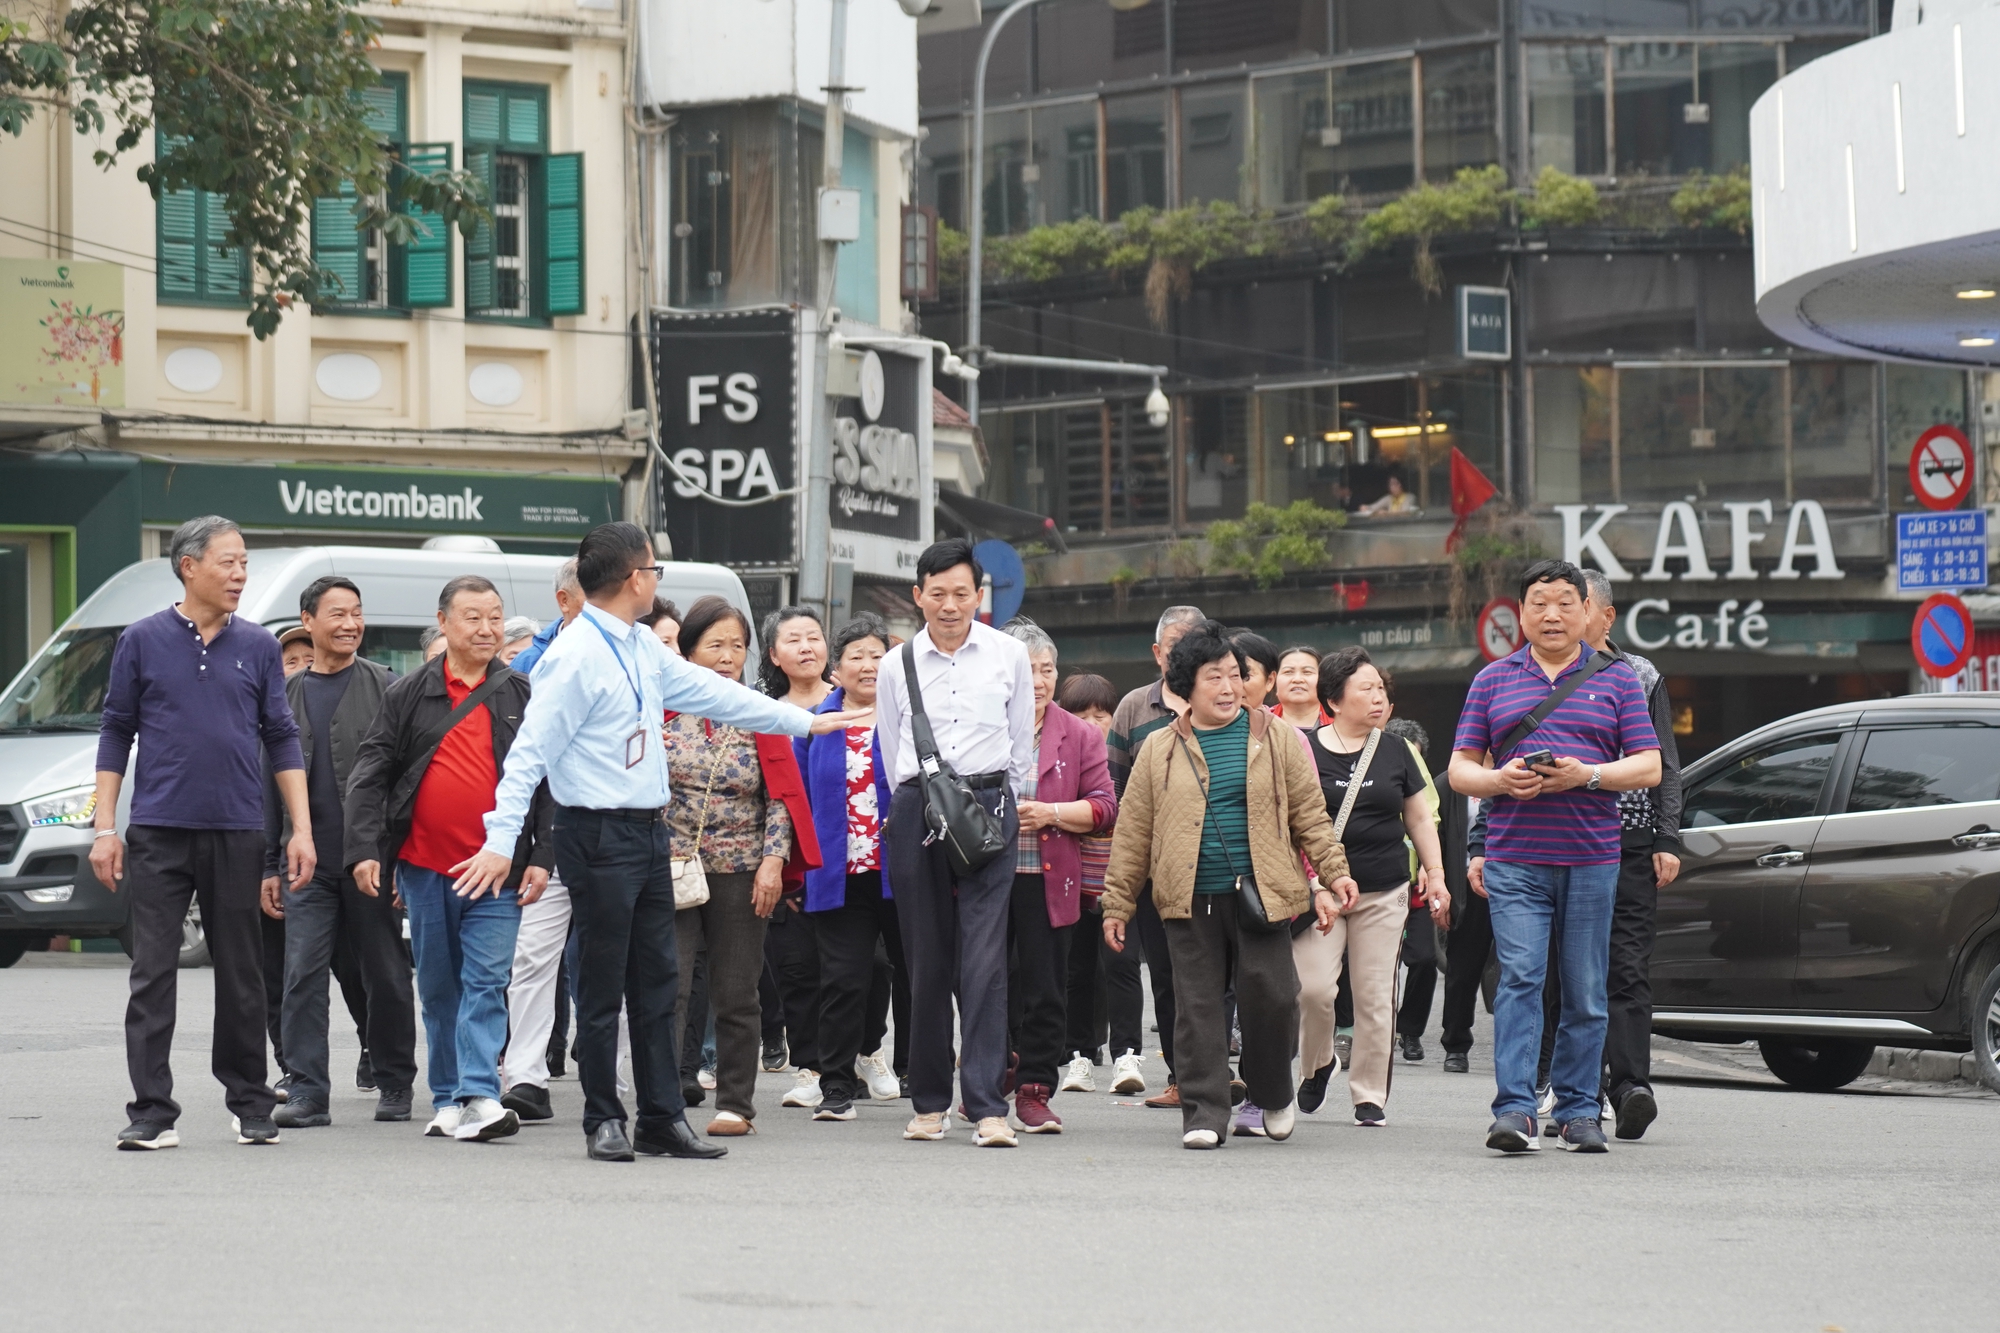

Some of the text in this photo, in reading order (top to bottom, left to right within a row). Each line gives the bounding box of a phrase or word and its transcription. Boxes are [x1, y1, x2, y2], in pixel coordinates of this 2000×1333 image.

[20, 276, 75, 289] Vietcombank
[688, 372, 759, 425] FS
[672, 447, 780, 498] SPA
[278, 479, 484, 521] Vietcombank
[523, 506, 539, 514] BANK
[553, 507, 578, 515] FOREIGN
[523, 514, 543, 522] TRADE
[1928, 520, 1938, 535] XE
[1949, 519, 1957, 533] 16
[1553, 499, 1846, 582] KAFA
[1361, 630, 1383, 645] 100
[1625, 598, 1770, 649] Café
